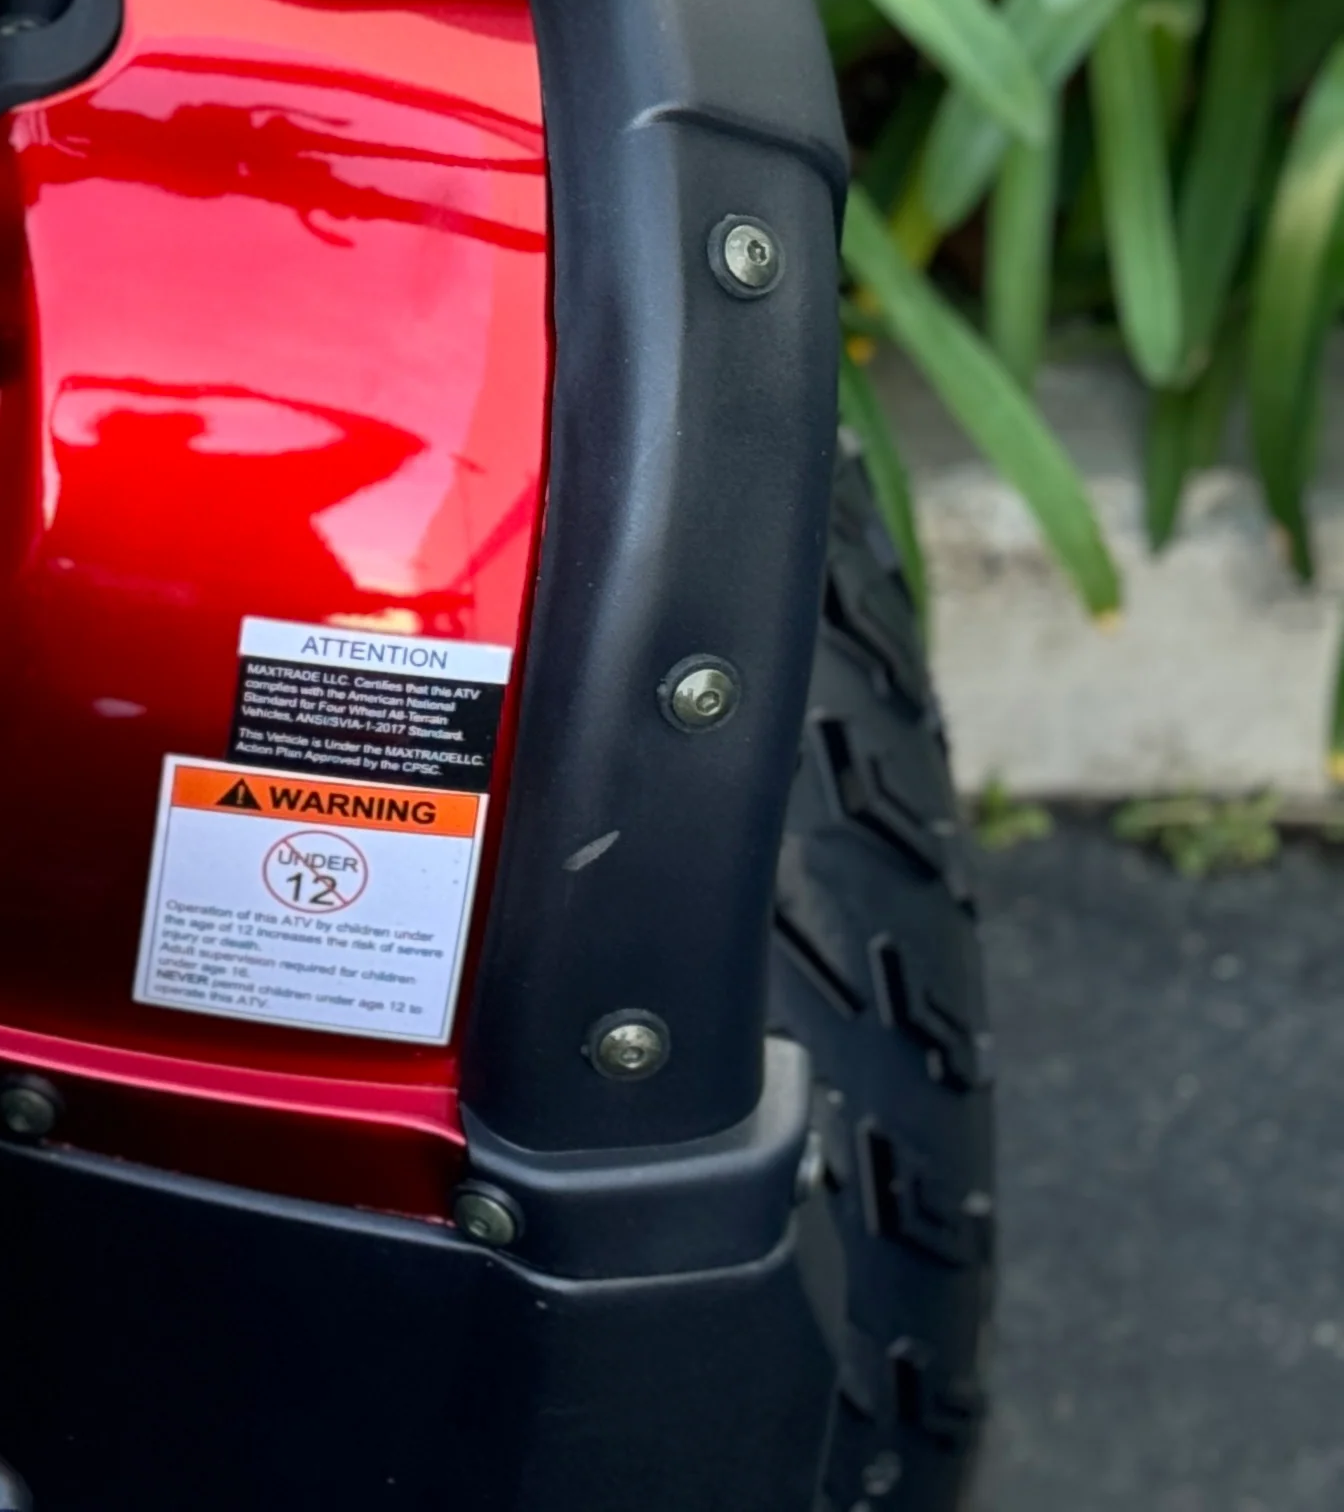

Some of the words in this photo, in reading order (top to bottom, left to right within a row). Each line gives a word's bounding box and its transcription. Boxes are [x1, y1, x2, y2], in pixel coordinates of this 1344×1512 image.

[300, 634, 447, 671] ATTENTION
[270, 787, 435, 824] WARNING
[278, 850, 358, 872] UNDER
[287, 873, 337, 906] 12
